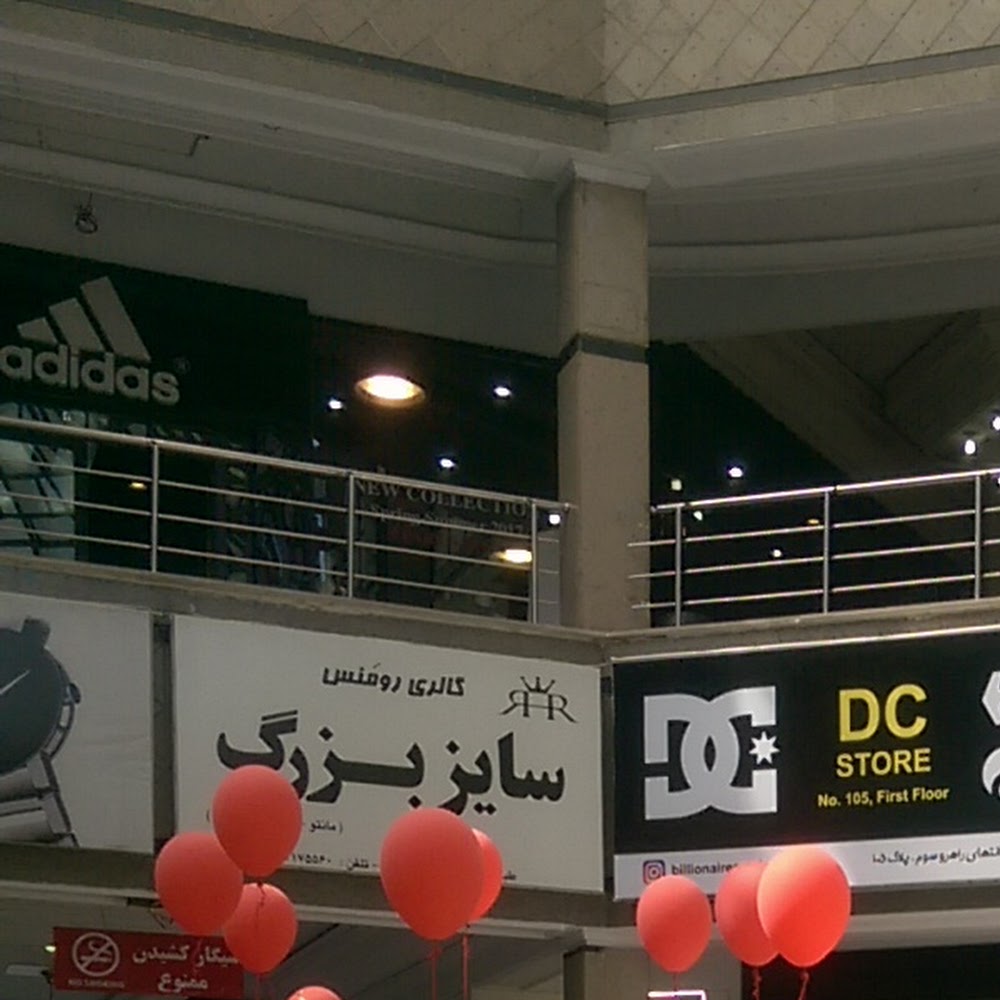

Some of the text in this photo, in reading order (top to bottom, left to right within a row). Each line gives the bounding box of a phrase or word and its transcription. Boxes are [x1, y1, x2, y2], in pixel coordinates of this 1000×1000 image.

[1, 344, 180, 405] adidas
[355, 479, 530, 518] NEW COLLECTIO
[407, 675, 465, 697] گالری
[838, 684, 928, 742] DC
[216, 709, 565, 816] سایز بزرگ
[835, 747, 931, 778] STORE
[818, 787, 949, 807] No. 105, First Floor
[132, 943, 190, 964] کشیدن
[157, 972, 209, 993] ممنوع
